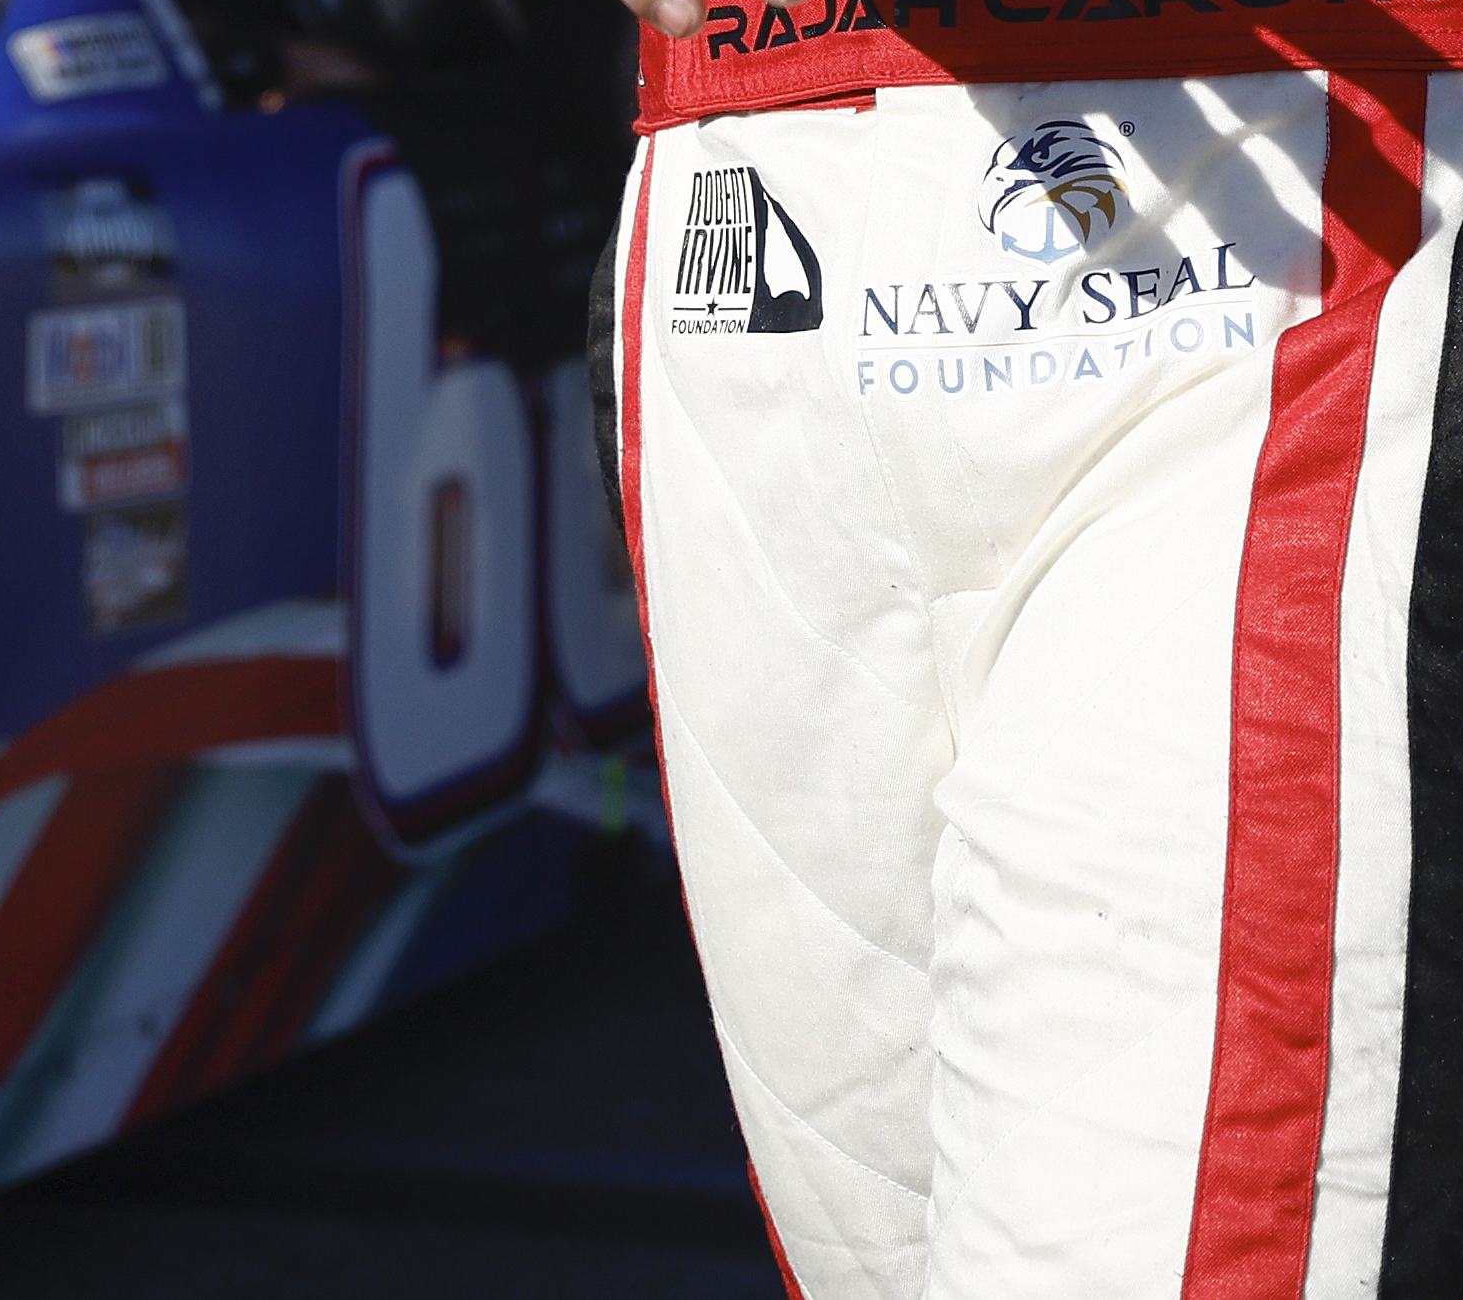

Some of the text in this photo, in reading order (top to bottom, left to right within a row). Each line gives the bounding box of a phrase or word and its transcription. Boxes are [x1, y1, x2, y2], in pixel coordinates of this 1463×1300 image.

[687, 166, 749, 227] ROBERT
[675, 226, 753, 295] IRVINE
[862, 240, 1262, 339] NAVY SEAL
[671, 319, 747, 335] FOUNDATION
[858, 309, 1259, 399] FOUNDATION
